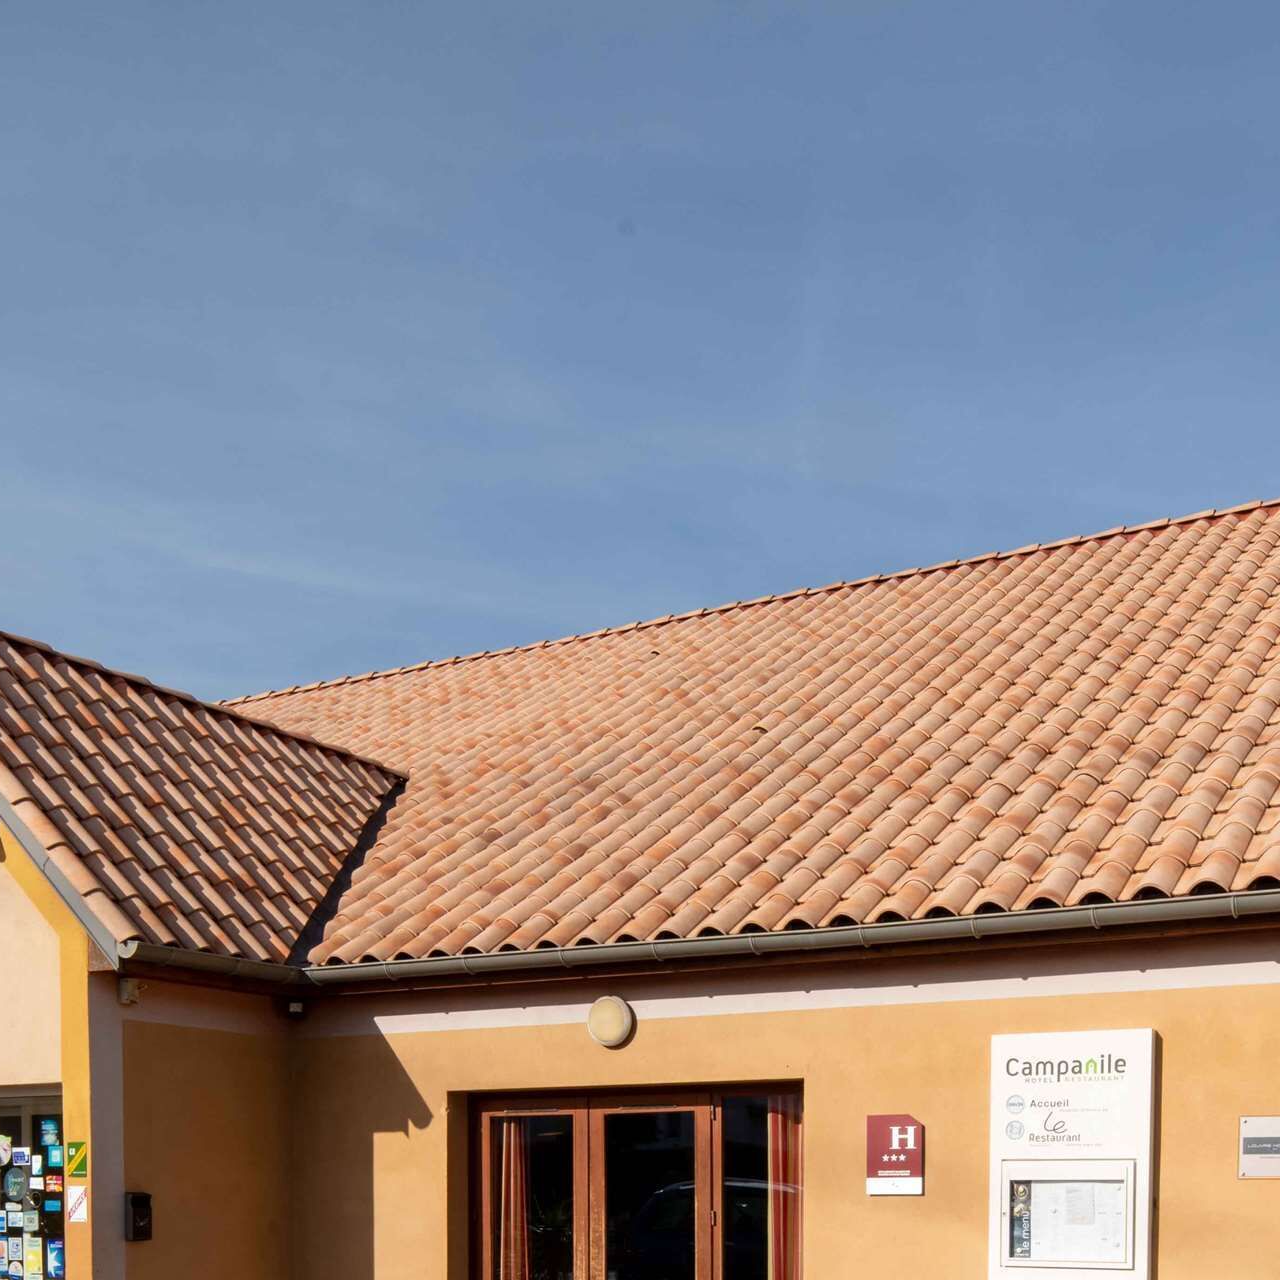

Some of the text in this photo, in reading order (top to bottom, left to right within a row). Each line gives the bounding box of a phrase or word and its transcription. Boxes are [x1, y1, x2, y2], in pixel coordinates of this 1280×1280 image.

[1005, 1053, 1127, 1083] Campanile
[1030, 1098, 1069, 1108] Accueil
[888, 1126, 917, 1150] H
[1028, 1133, 1081, 1143] Restaurant
[1021, 1211, 1030, 1239] menu
